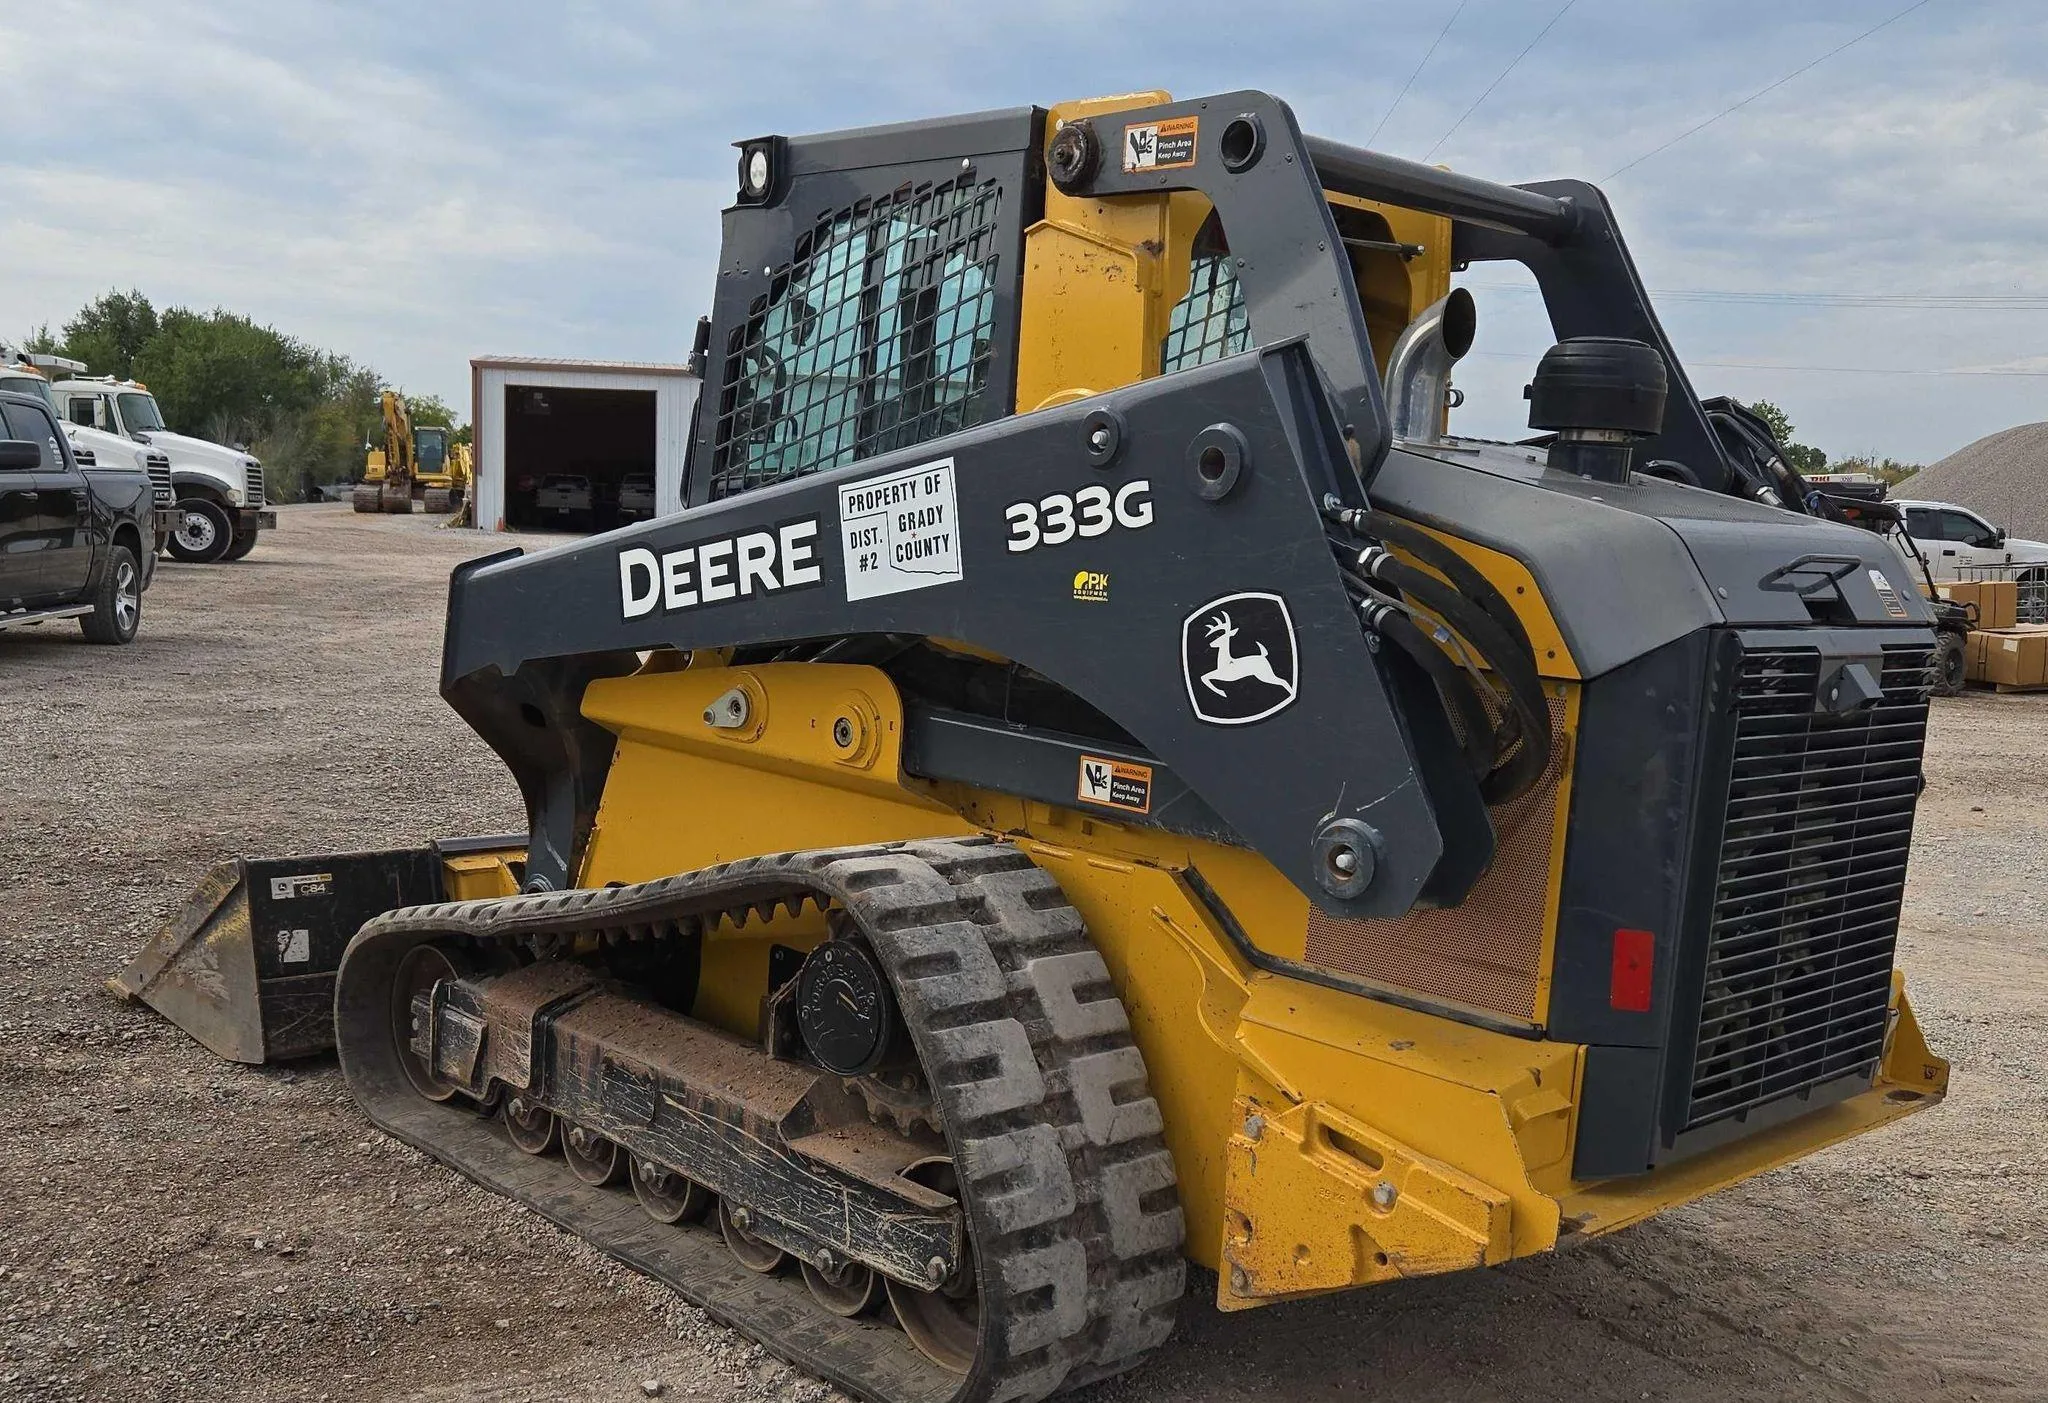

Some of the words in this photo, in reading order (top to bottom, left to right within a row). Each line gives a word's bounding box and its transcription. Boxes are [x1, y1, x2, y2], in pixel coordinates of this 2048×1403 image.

[1157, 152, 1171, 160] Keep
[1172, 150, 1187, 159] Away
[1158, 140, 1176, 150] Pinch
[1177, 139, 1192, 148] Area
[848, 479, 917, 514] PROPERTY
[924, 473, 942, 496] OF
[898, 504, 943, 533] GRADY
[1005, 480, 1153, 552] 333G
[850, 527, 883, 549] DIST.
[895, 533, 950, 563] COUNTY
[619, 519, 821, 618] DEERE
[859, 552, 879, 573] #2
[1112, 791, 1126, 801] Keep
[1126, 794, 1141, 804] Away
[1113, 781, 1130, 792] Pinch
[1130, 785, 1146, 795] Area
